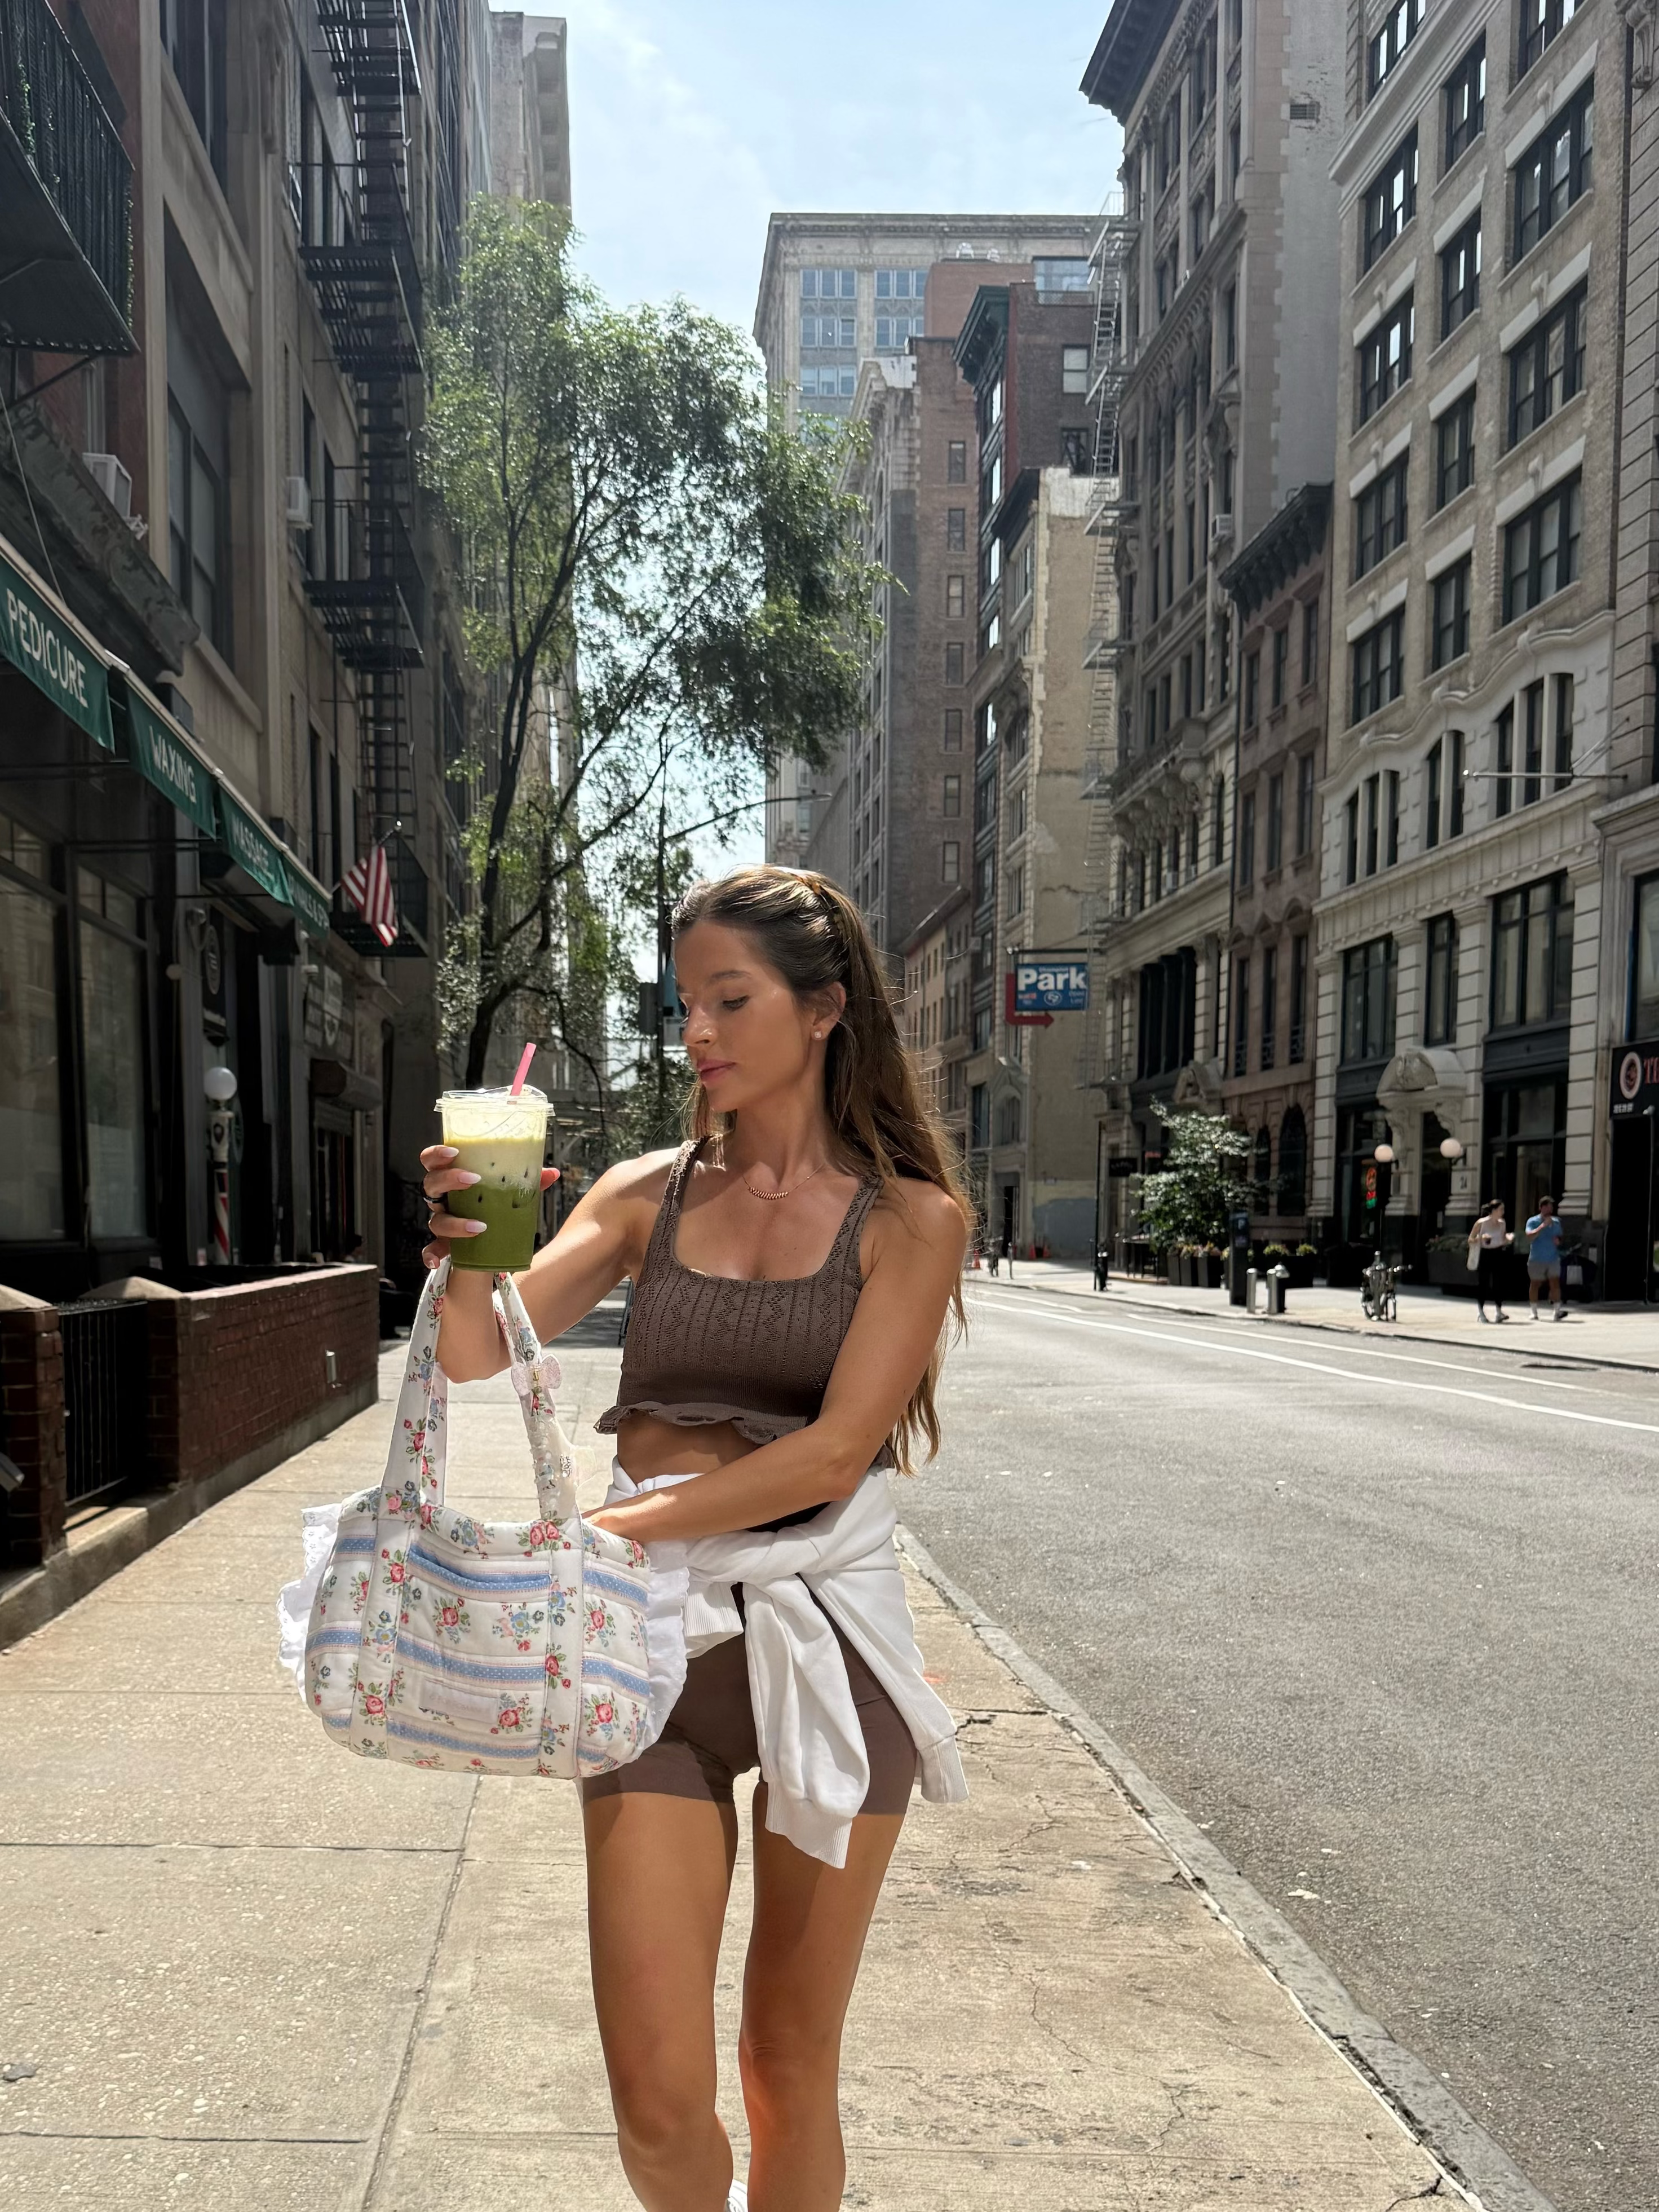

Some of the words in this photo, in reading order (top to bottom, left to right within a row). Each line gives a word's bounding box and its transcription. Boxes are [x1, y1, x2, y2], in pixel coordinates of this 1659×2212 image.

[6, 588, 89, 709] PEDICURE
[149, 725, 197, 803] WAXING
[1017, 966, 1087, 991] Park
